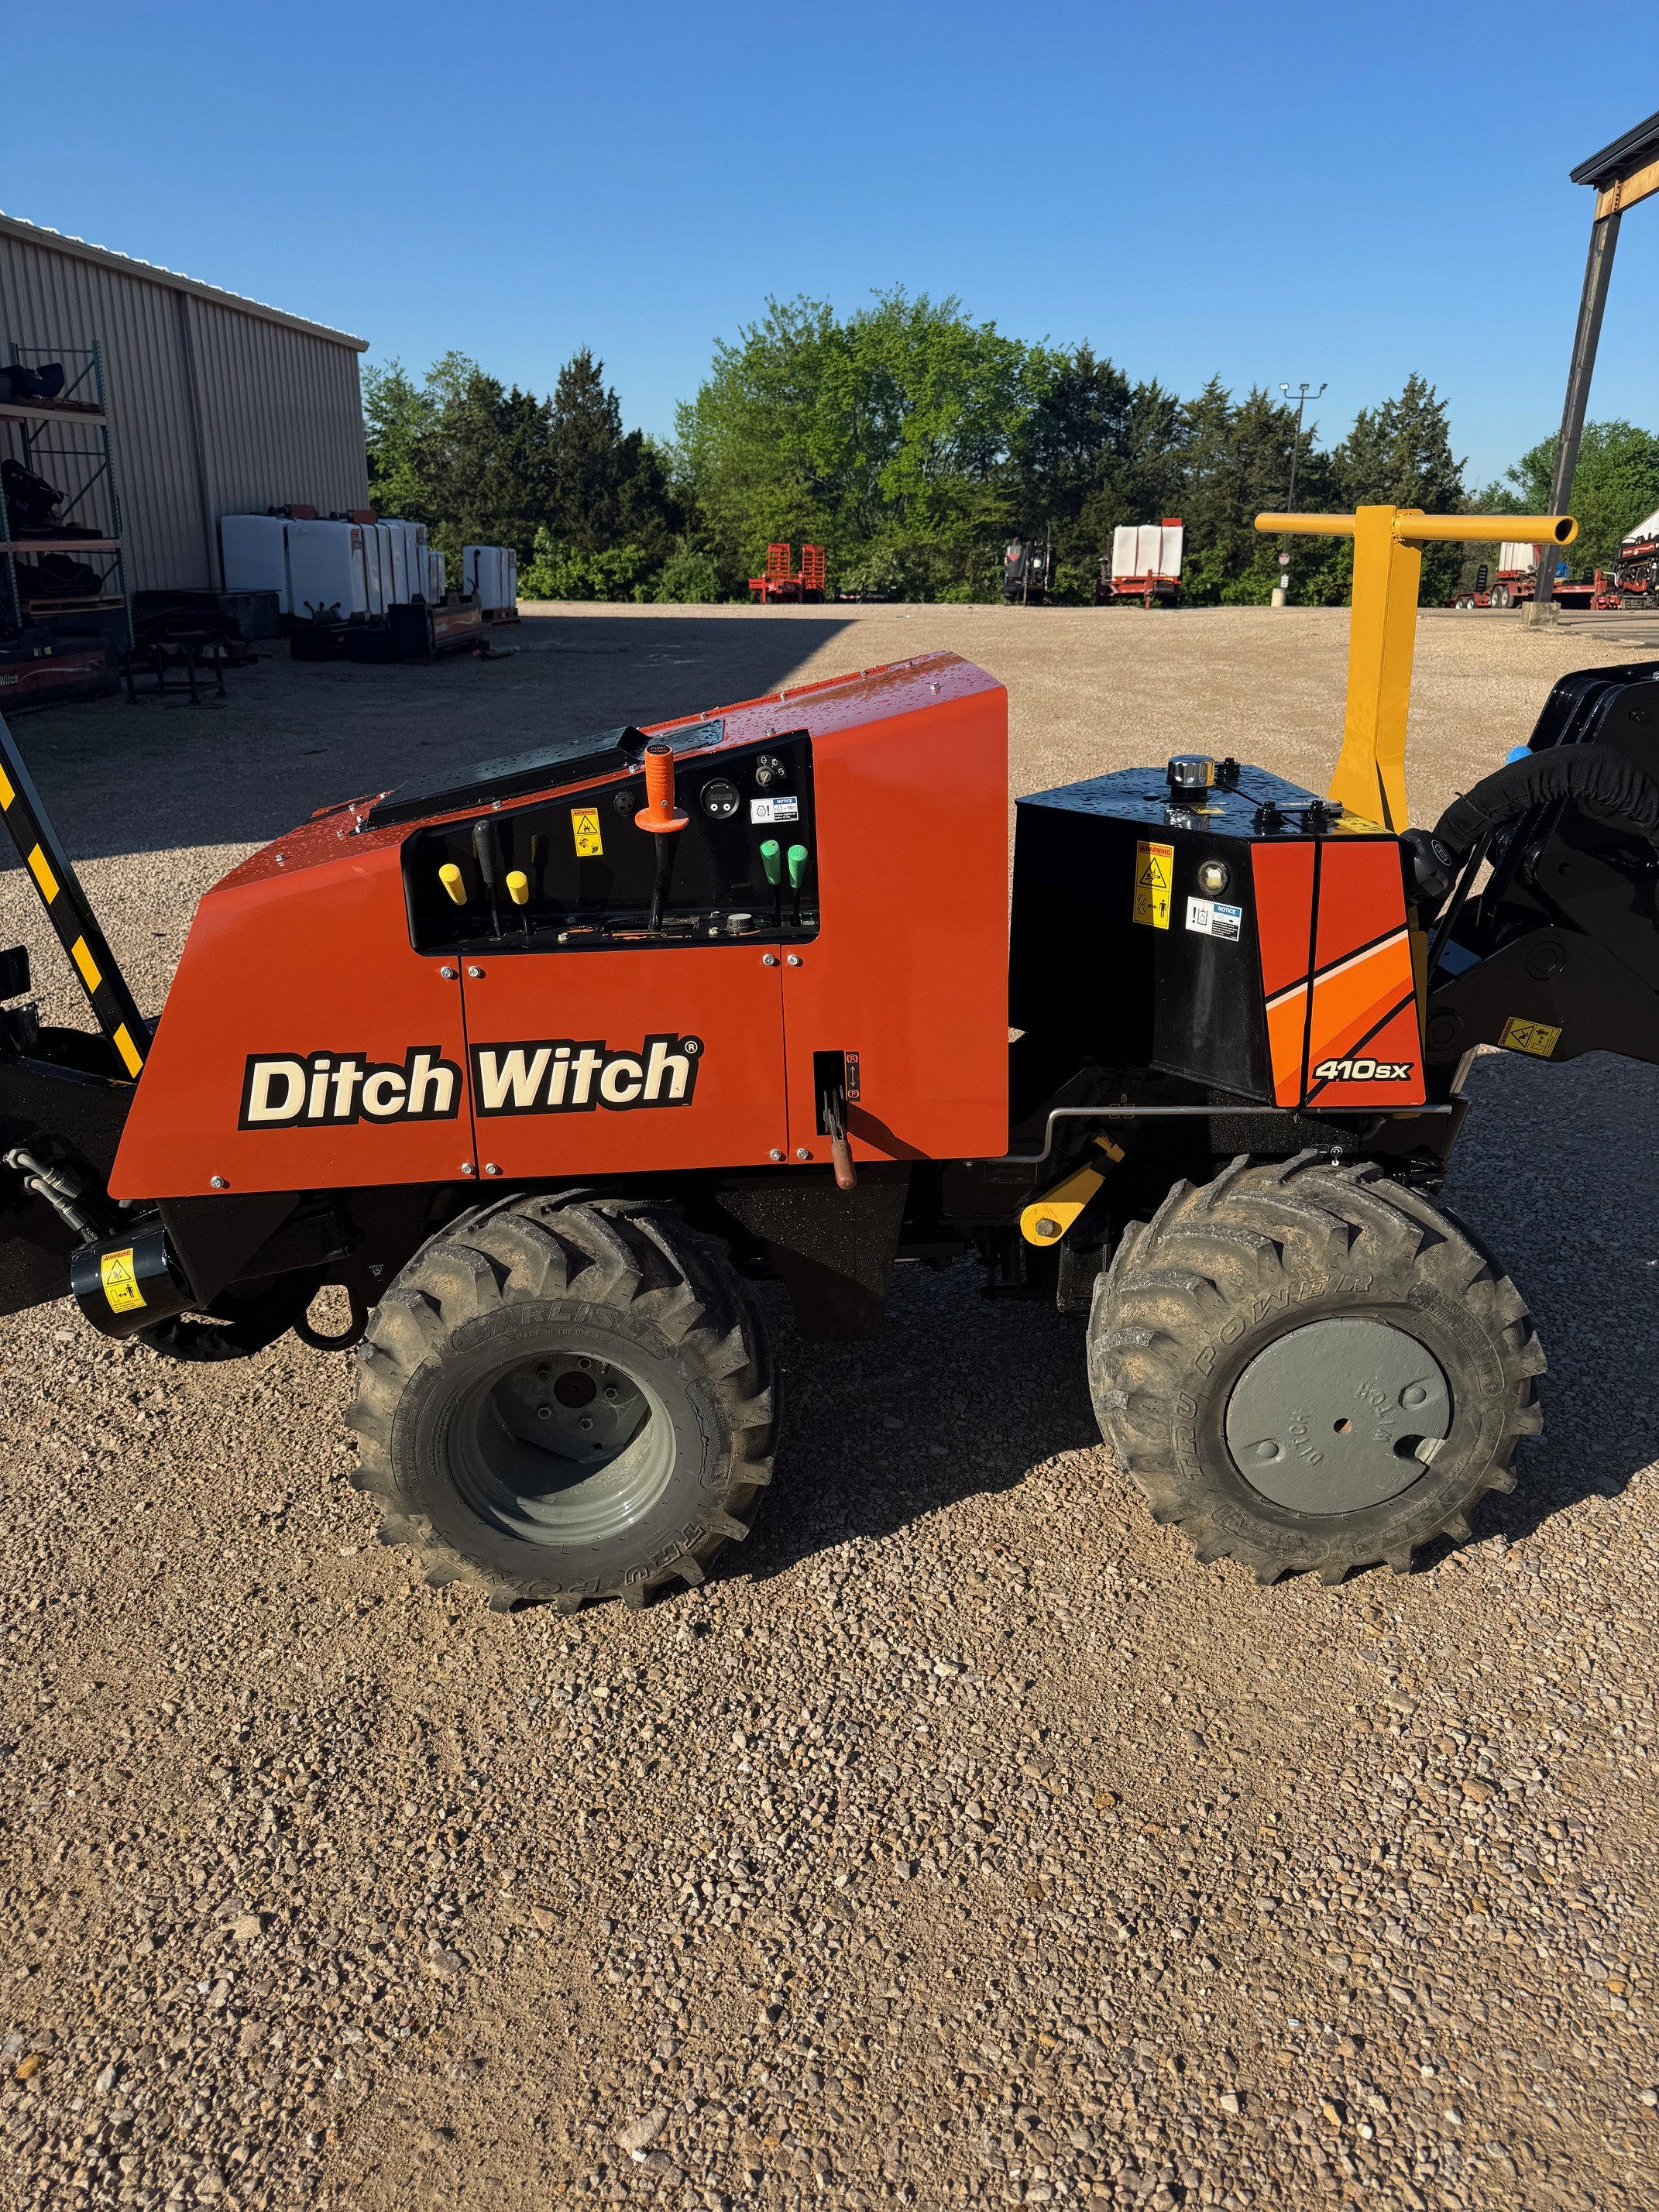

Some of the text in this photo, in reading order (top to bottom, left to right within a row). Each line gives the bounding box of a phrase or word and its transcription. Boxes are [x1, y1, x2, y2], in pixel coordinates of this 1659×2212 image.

[1146, 845, 1171, 856] WARNING
[1218, 906, 1236, 915] NOTICE
[247, 1054, 454, 1121] Ditch
[465, 1302, 671, 1352] CARLISLE
[518, 1331, 541, 1341] MADE
[575, 1330, 604, 1341] U.S.A.
[1175, 1272, 1374, 1481] TRU POWER
[624, 1522, 707, 1585] TRU
